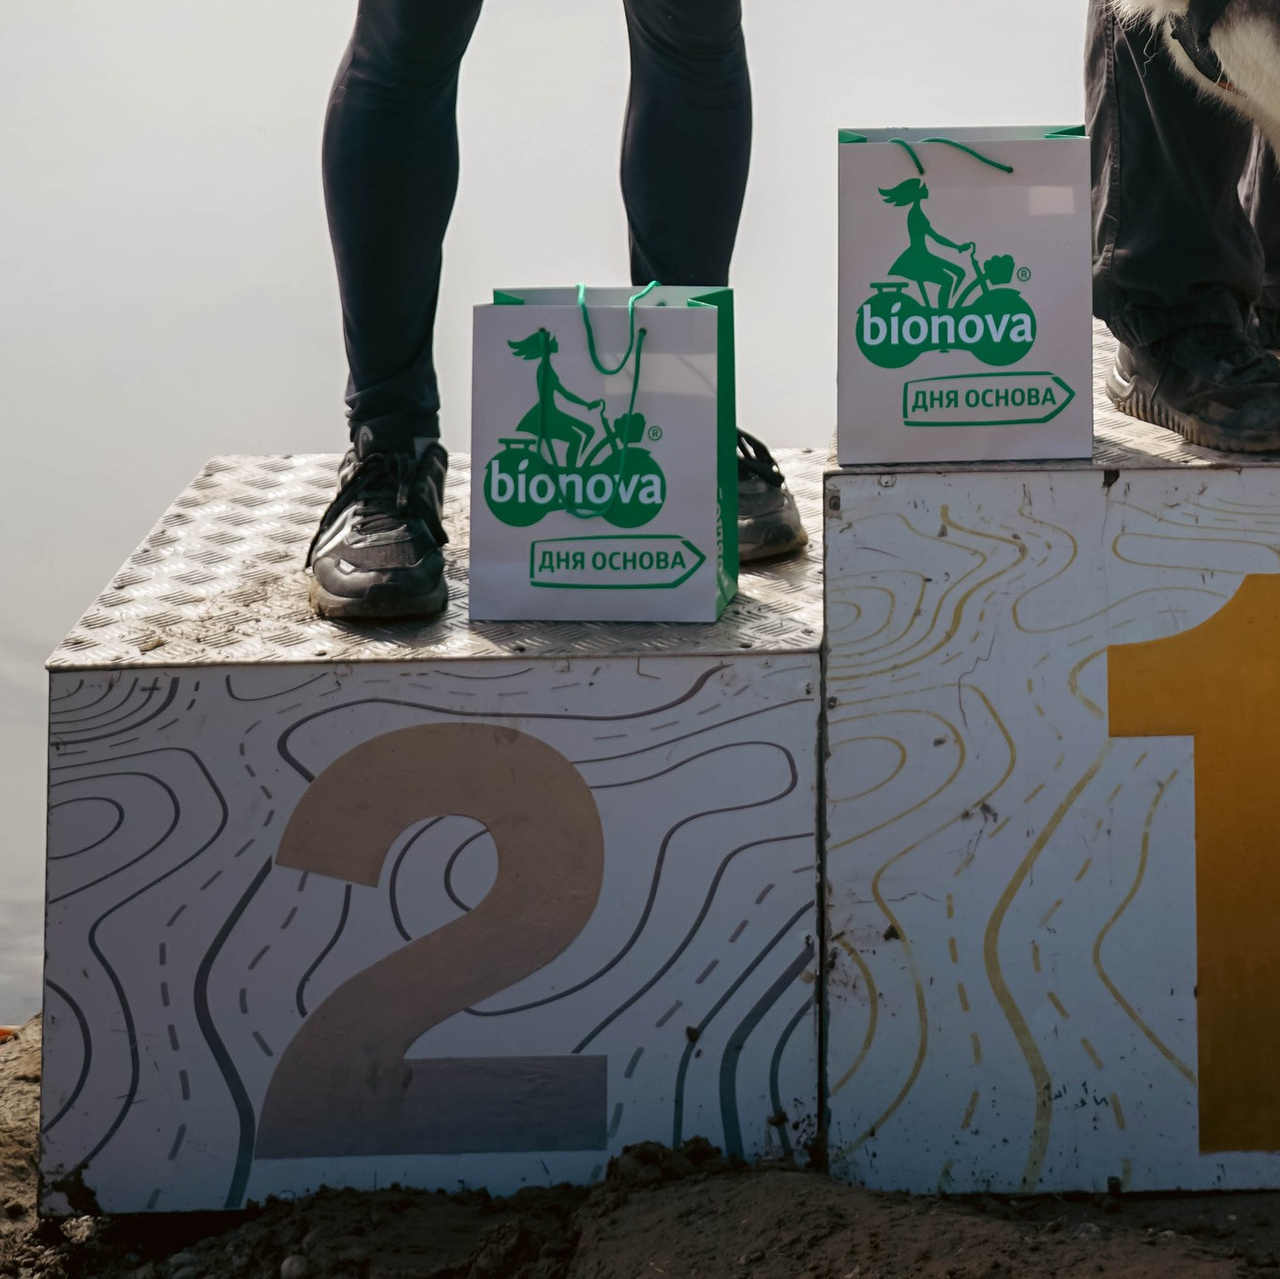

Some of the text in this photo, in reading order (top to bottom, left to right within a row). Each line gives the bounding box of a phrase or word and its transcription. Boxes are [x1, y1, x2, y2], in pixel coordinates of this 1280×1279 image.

[862, 301, 1034, 346] bionova
[912, 387, 1056, 412] ДНЯ ОСНОВА
[490, 459, 663, 504] bionova
[539, 550, 686, 573] ДНЯ ОСНОВА
[252, 723, 606, 1158] 2
